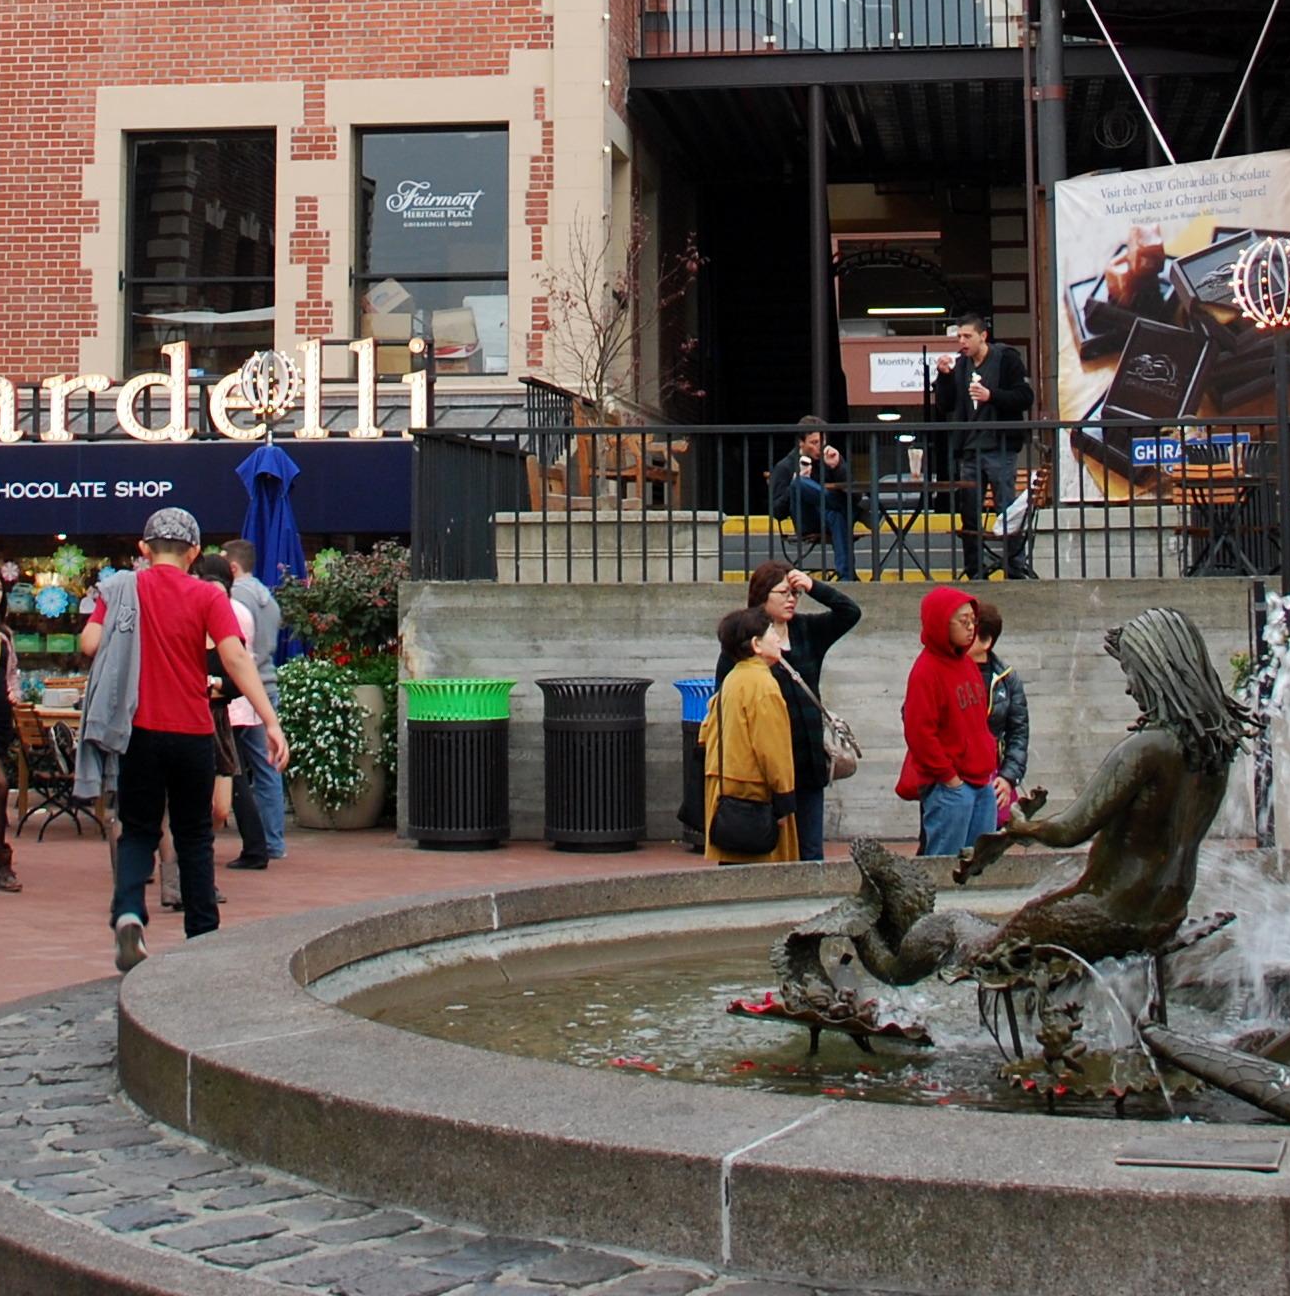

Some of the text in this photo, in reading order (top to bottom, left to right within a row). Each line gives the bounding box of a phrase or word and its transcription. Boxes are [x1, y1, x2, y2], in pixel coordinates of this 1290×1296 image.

[1100, 167, 1271, 200] Visit the NEW Ghirardelli Chocolate
[386, 180, 485, 212] Fairmont
[1104, 184, 1267, 217] Marketplace at Ghirardelli Square!
[403, 209, 472, 218] HERITAGE PLACE
[877, 357, 914, 367] Monthly
[114, 481, 173, 498] SHOP
